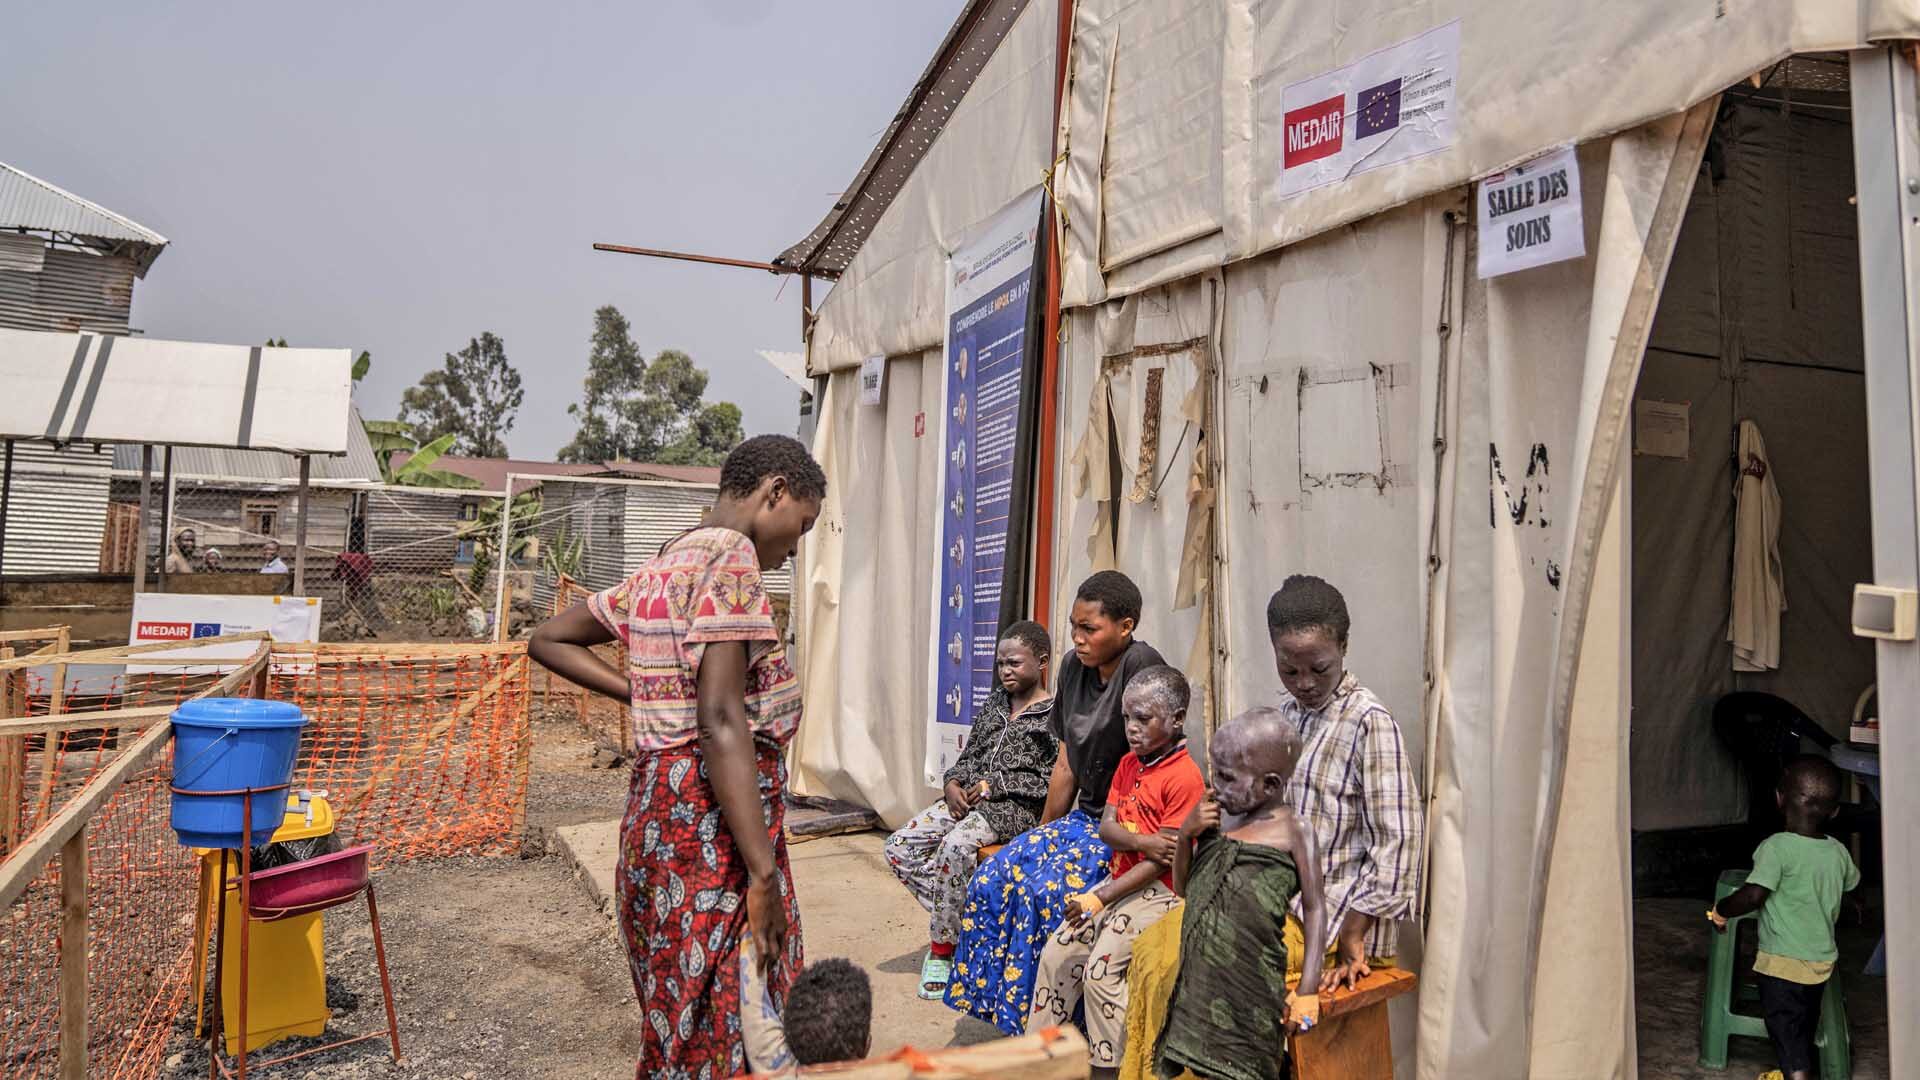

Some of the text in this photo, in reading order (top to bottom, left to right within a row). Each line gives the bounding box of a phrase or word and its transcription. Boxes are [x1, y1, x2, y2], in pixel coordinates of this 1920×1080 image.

[1288, 111, 1340, 153] MEDAIR
[1488, 169, 1568, 218] SALLE DES
[1506, 215, 1551, 252] SOINS
[987, 301, 994, 316] LE
[1009, 286, 1018, 302] EN
[141, 626, 189, 637] MEDAIR
